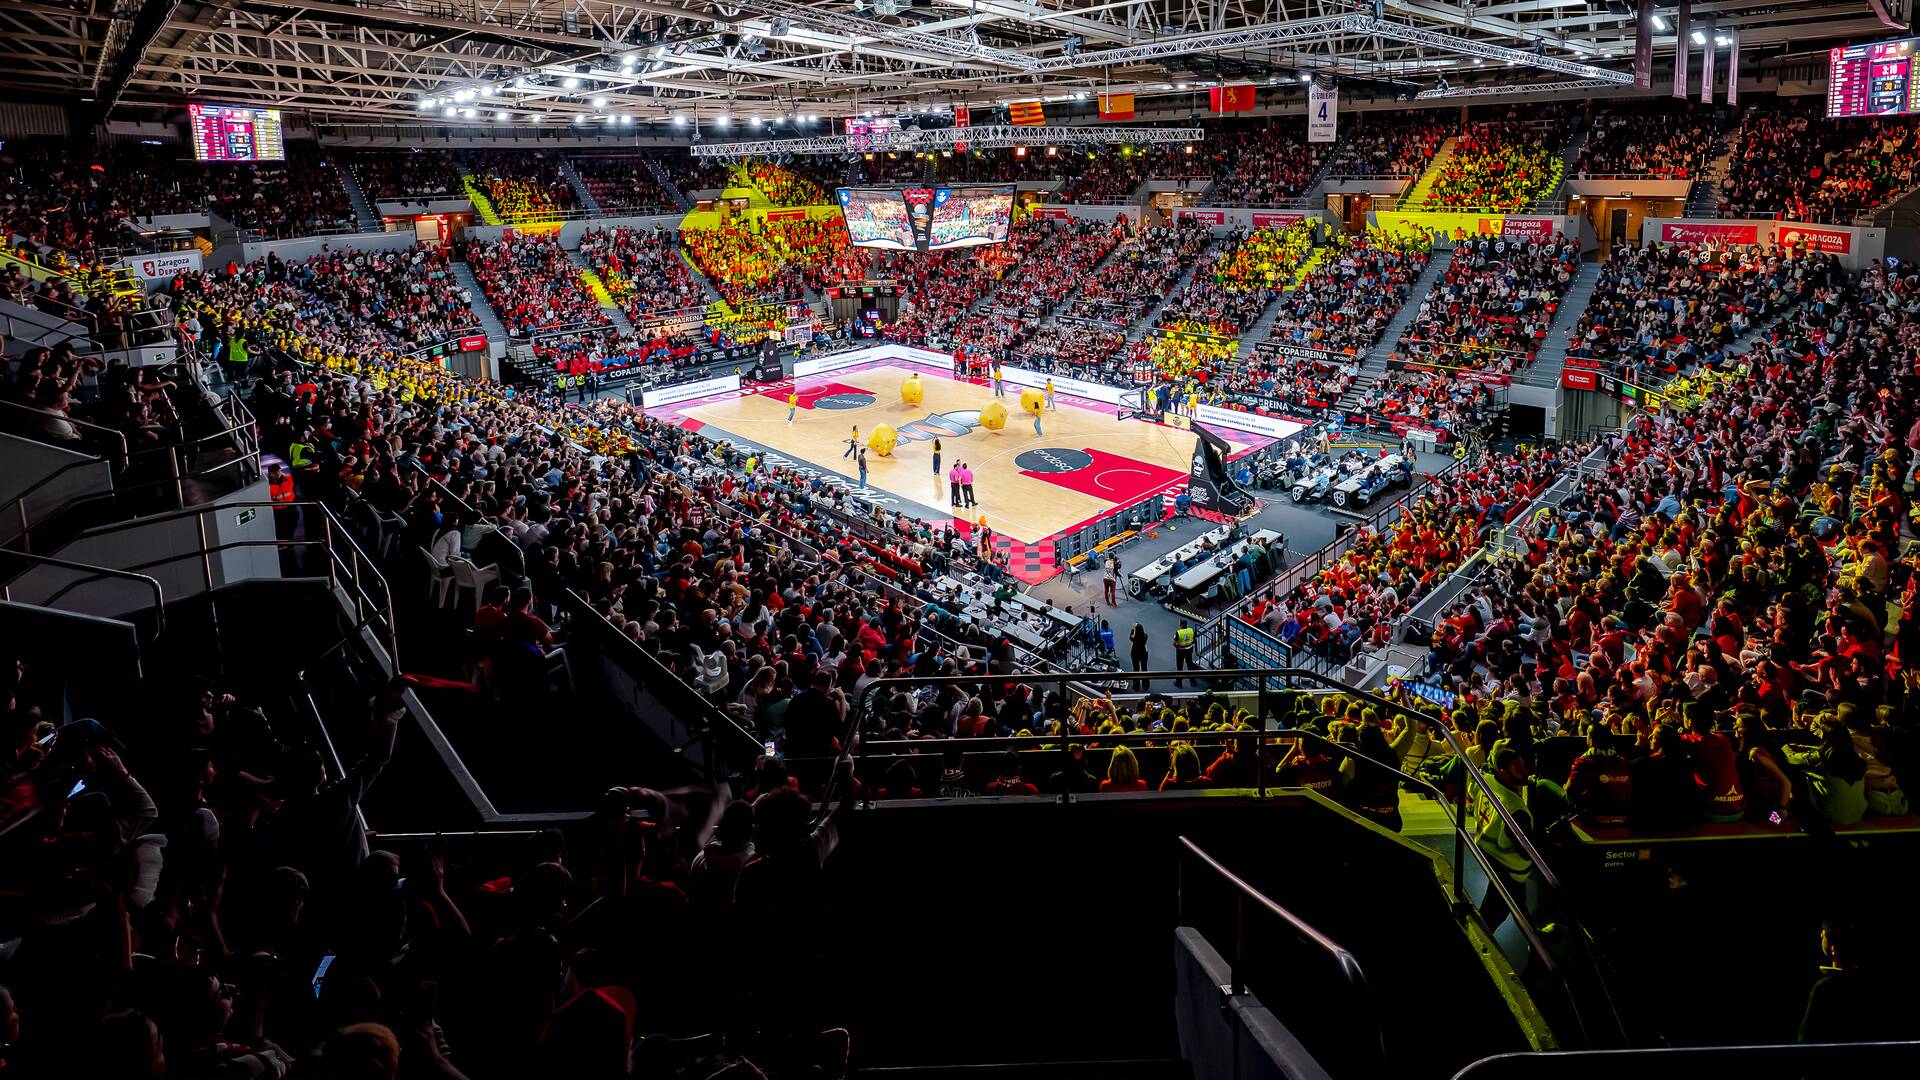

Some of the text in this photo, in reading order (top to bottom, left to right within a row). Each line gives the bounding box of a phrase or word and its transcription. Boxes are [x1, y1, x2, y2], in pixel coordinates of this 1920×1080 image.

[1318, 102, 1328, 122] 4
[1504, 220, 1541, 229] Zaragoza
[157, 257, 190, 268] Zaragoza
[664, 318, 682, 326] COPA
[1278, 346, 1300, 357] COPA
[1303, 350, 1328, 360] REINA
[609, 367, 631, 378] COPA
[1265, 399, 1289, 411] REINA
[1033, 449, 1074, 472] endesa
[1606, 851, 1637, 859] Sector
